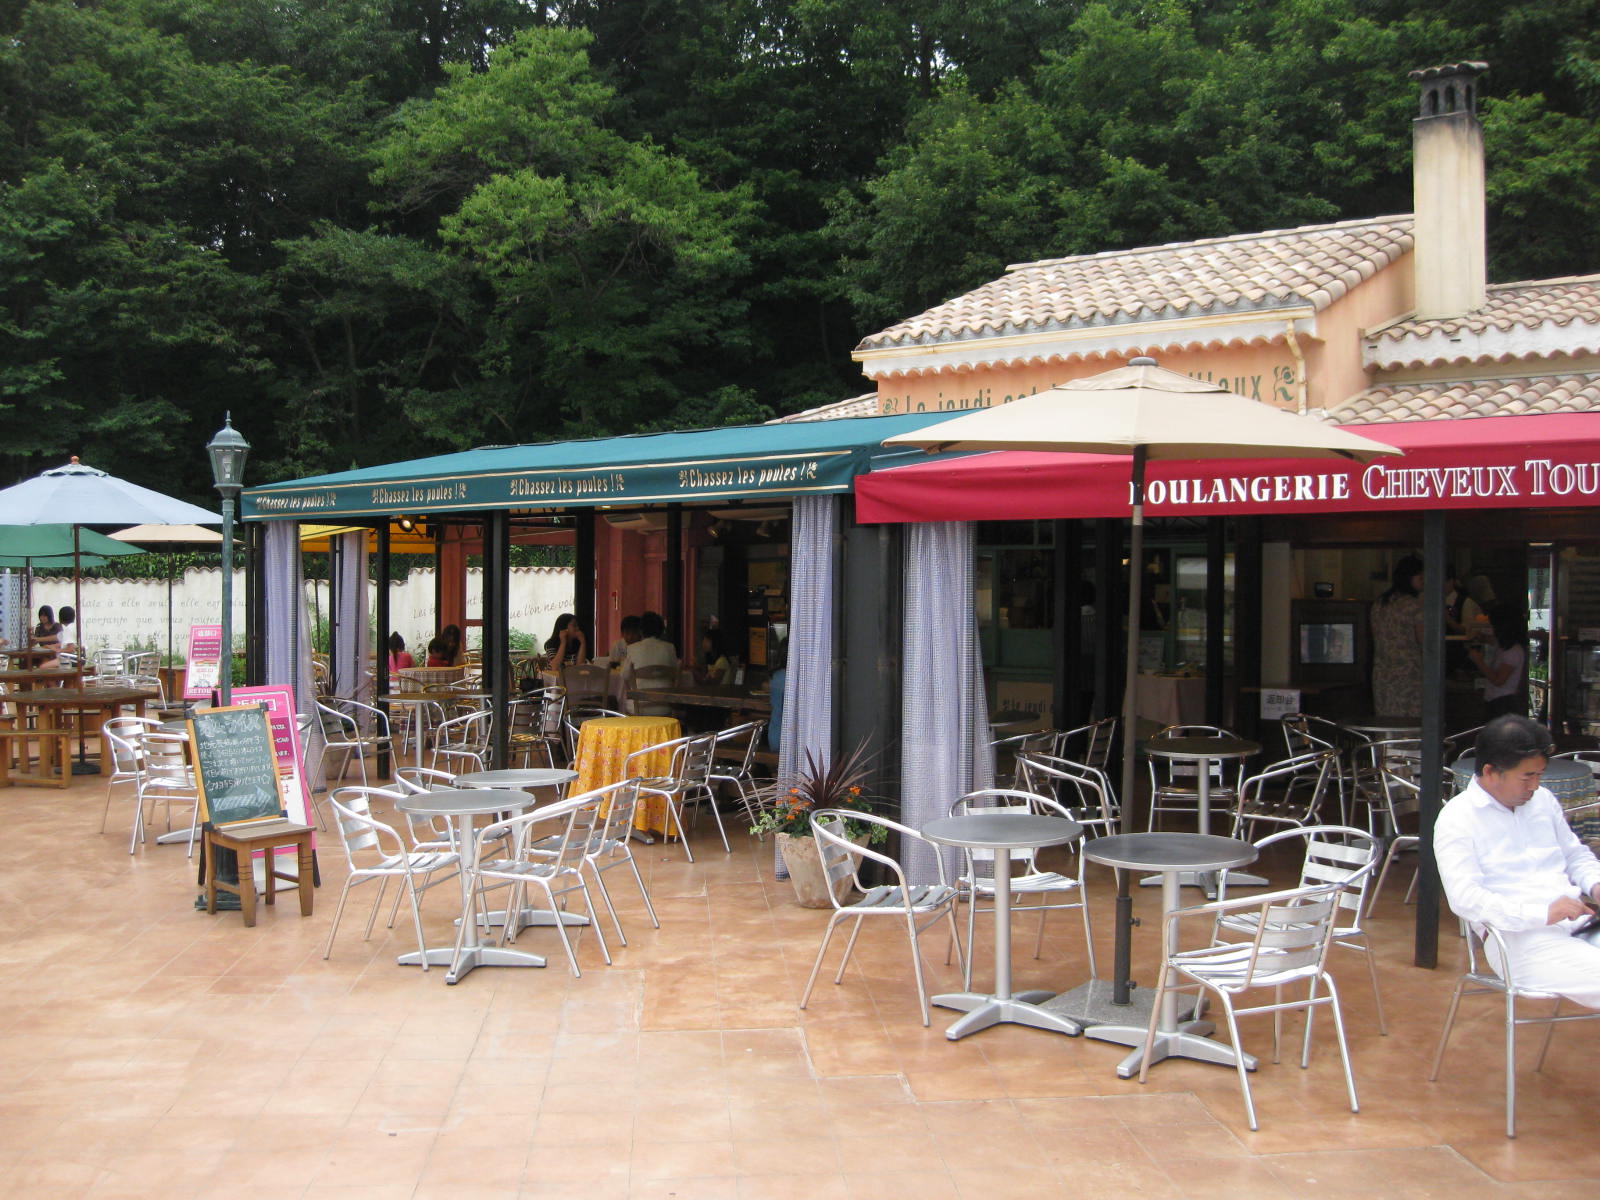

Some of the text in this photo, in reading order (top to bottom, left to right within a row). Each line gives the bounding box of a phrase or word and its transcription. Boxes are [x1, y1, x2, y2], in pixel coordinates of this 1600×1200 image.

[518, 478, 556, 496] Chassez
[558, 477, 574, 494] les
[576, 474, 609, 496] poules
[689, 467, 734, 488] Chassez
[737, 466, 755, 484] les
[758, 464, 797, 486] poules
[1361, 464, 1519, 499] CHEVEUX
[288, 496, 301, 508] les
[301, 493, 325, 510] poules
[379, 488, 410, 504] Chassez
[411, 486, 424, 502] les
[426, 483, 453, 504] poules
[558, 597, 576, 608] voi
